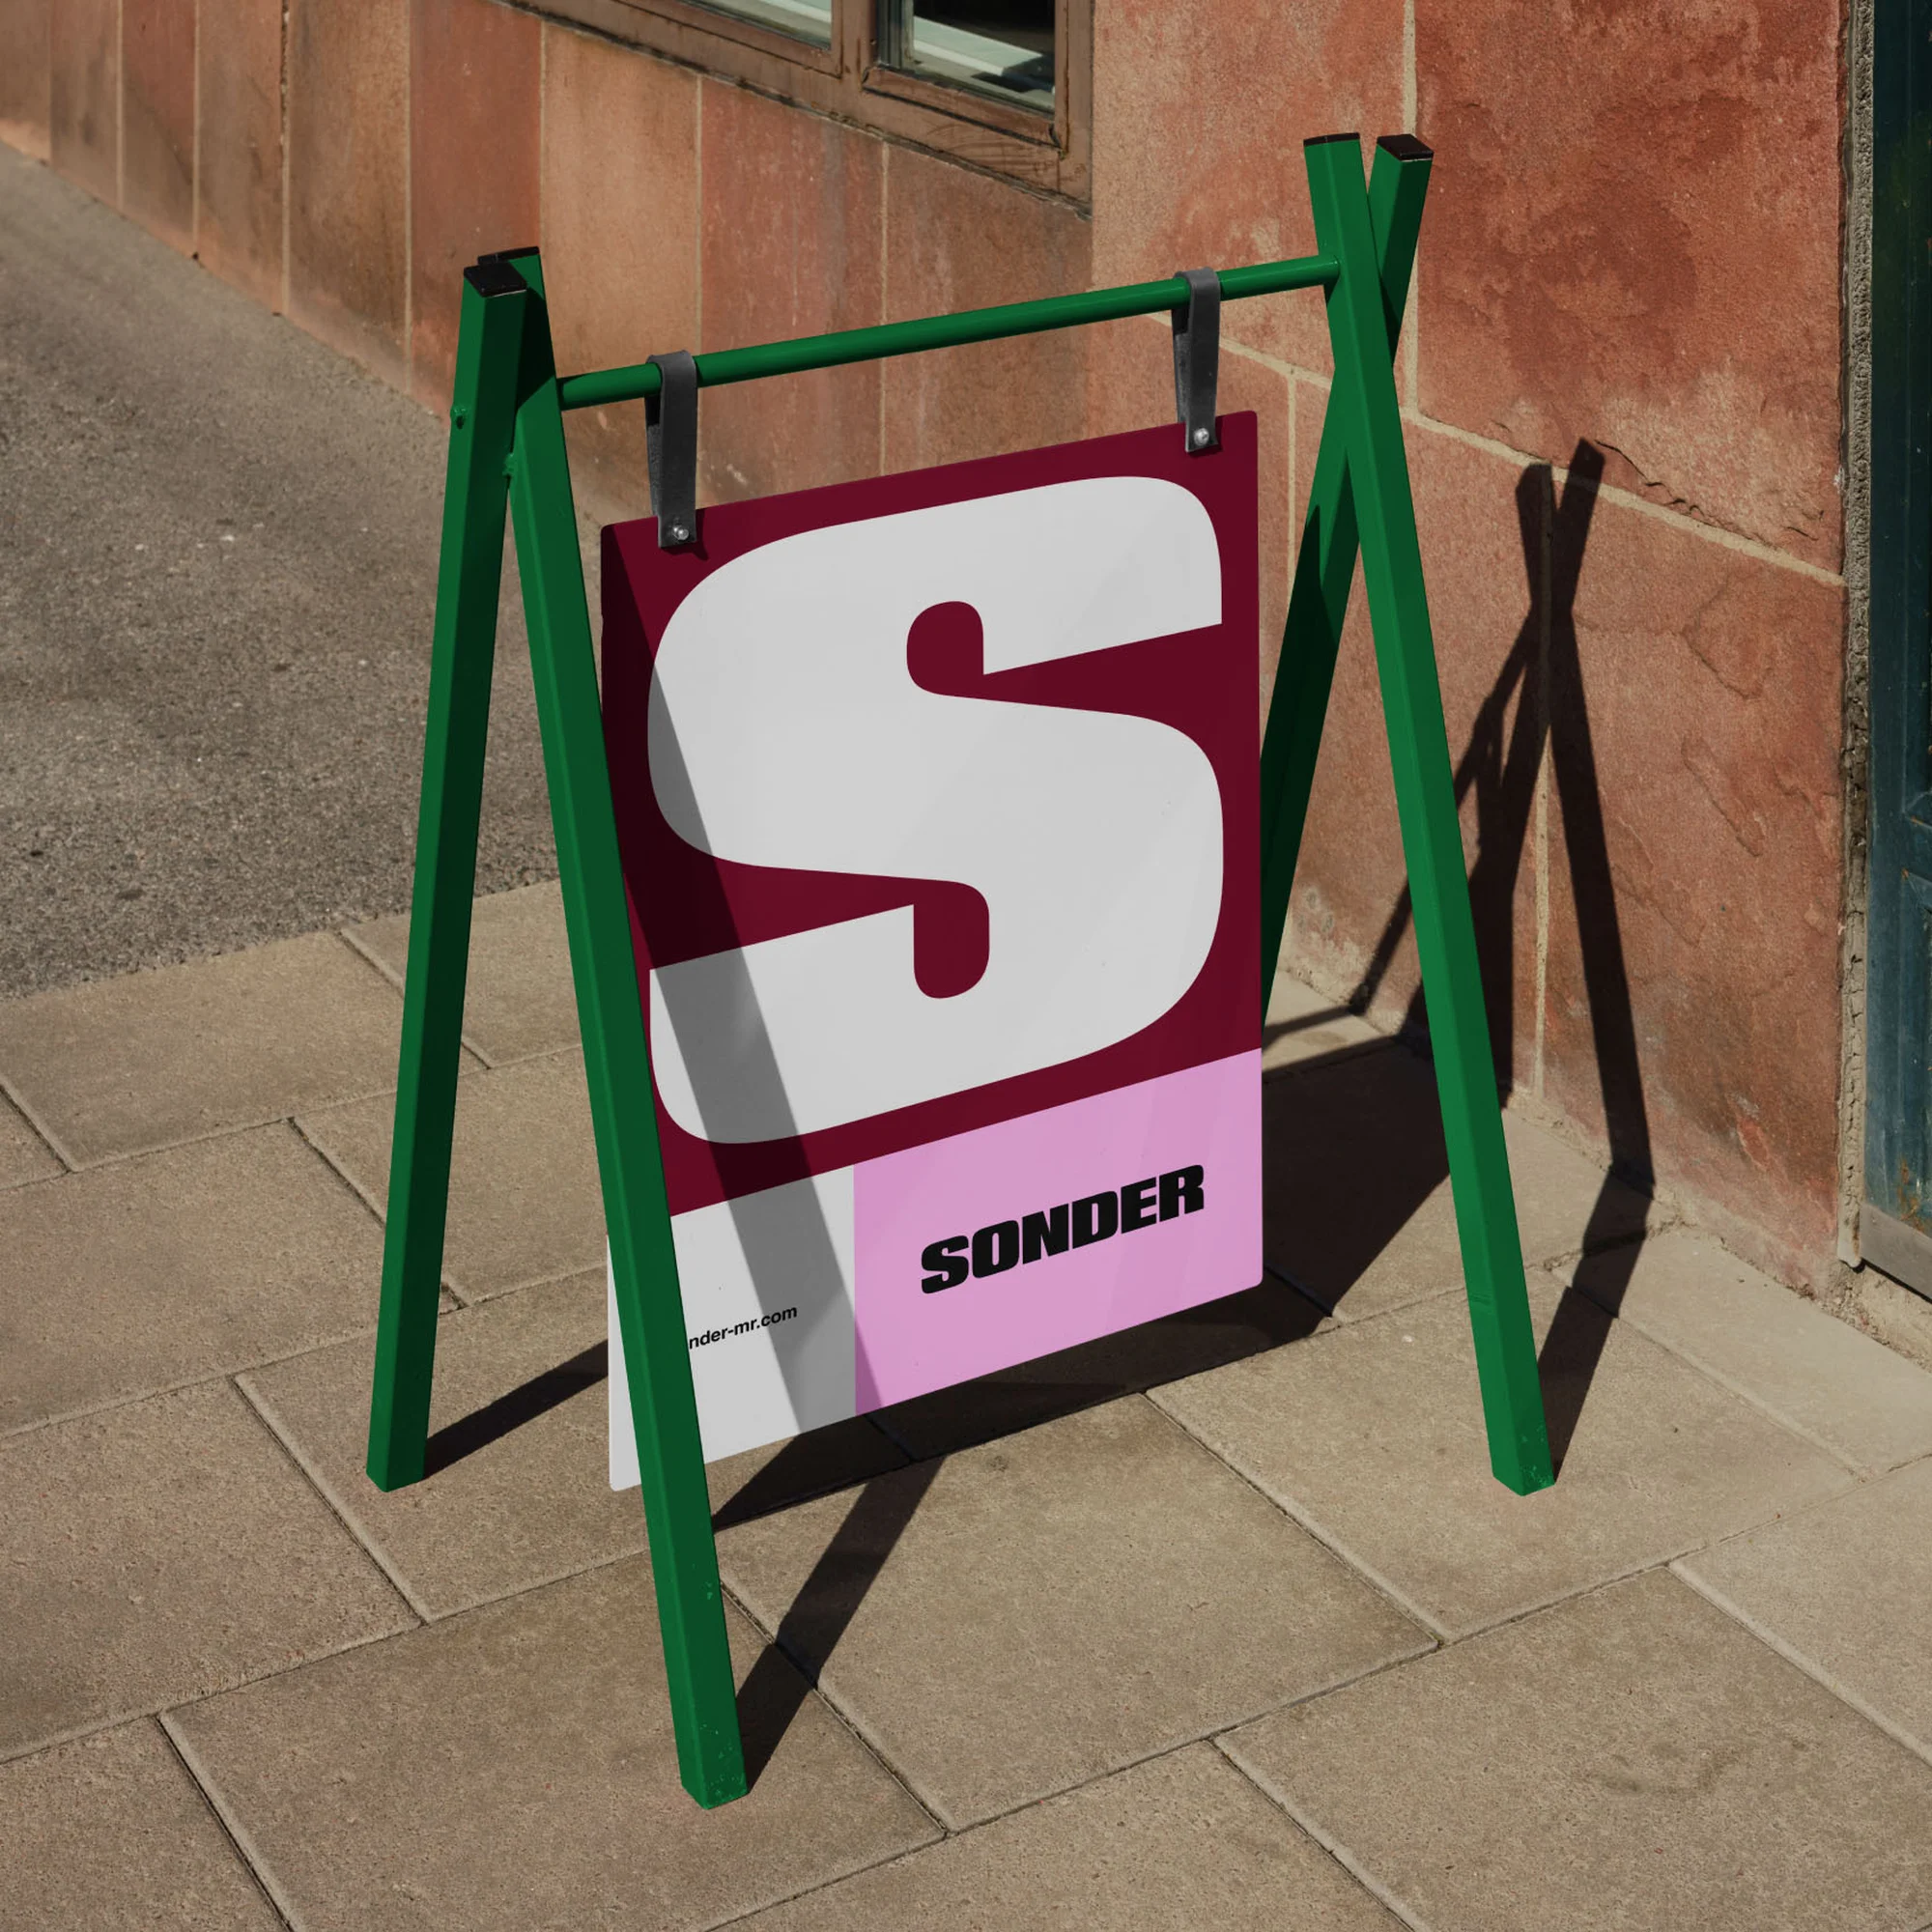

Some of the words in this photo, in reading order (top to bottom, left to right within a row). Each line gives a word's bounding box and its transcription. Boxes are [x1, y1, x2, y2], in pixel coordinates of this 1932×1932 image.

[647, 476, 1224, 1144] S
[921, 1164, 1205, 1295] SONDER
[689, 1307, 798, 1350] nder-mr.com
